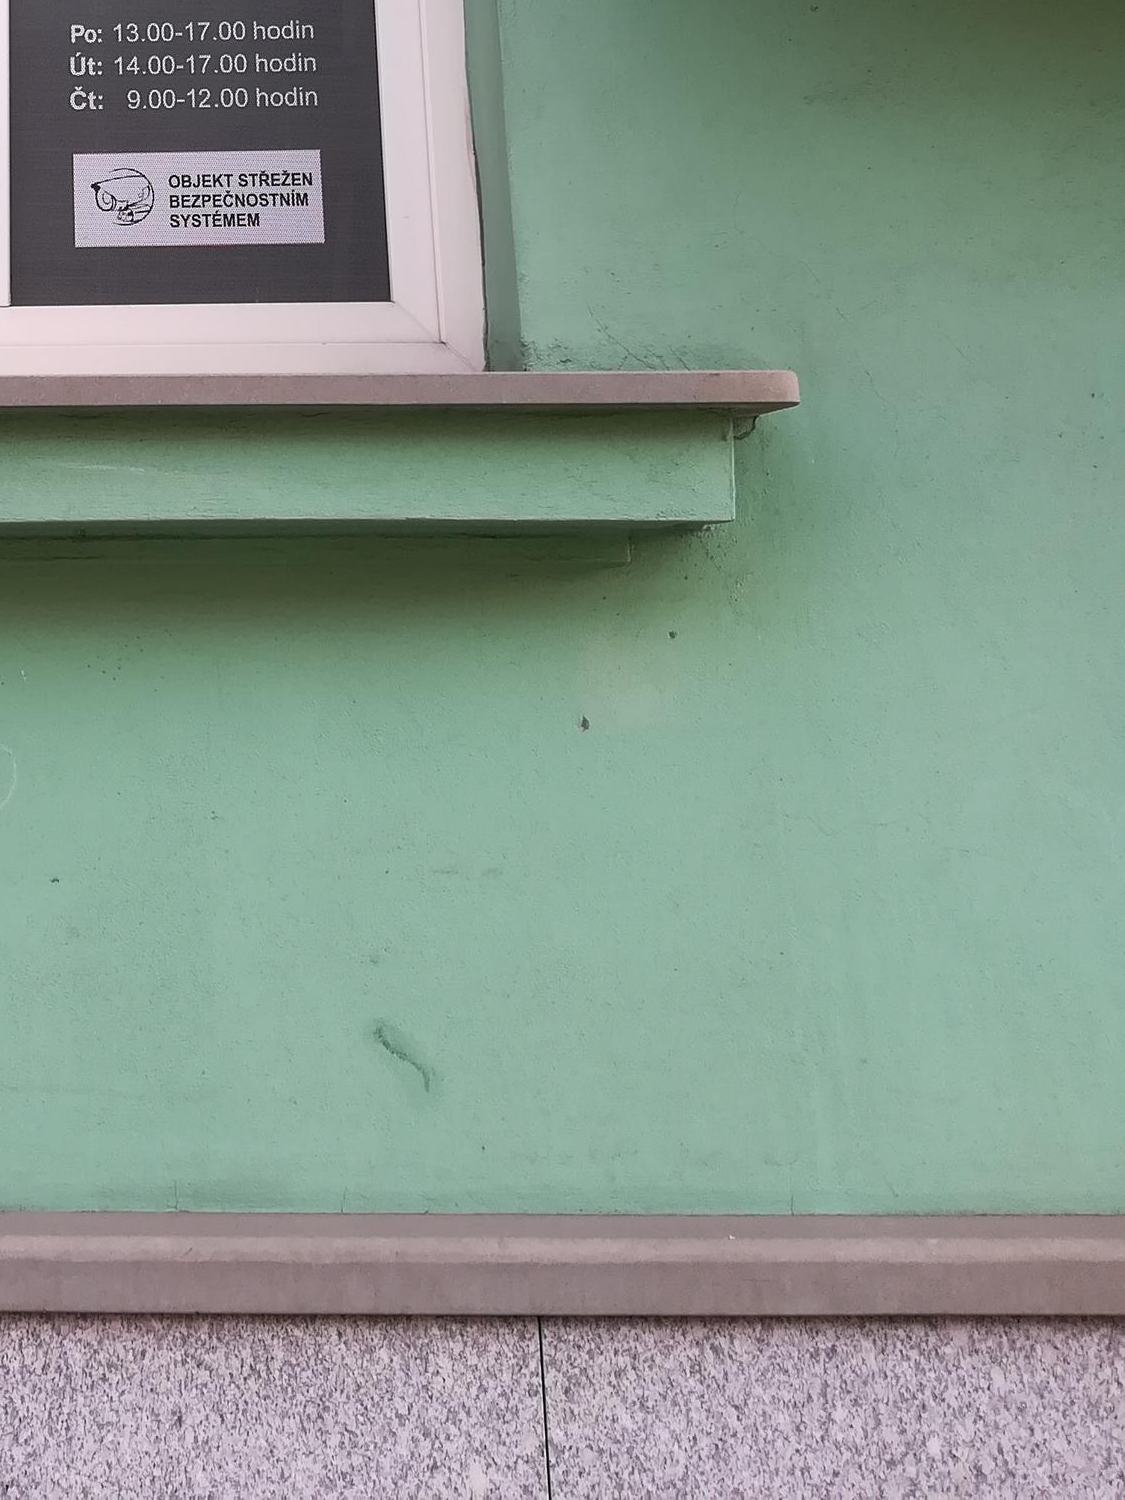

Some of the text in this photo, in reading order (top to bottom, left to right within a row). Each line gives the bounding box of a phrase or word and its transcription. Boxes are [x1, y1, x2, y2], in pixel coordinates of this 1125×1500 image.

[70, 20, 315, 43] Po: 13.00-17.00 hodin
[70, 52, 316, 76] Út: 14.00-17.00 hodin
[70, 87, 318, 110] Čt: 9.00-12.00 hodin
[168, 170, 313, 189] OBJEKT STŘEŽEN
[169, 190, 309, 208] BEZPEČNOSTNÍM
[169, 210, 260, 228] SYSTÉMEM
